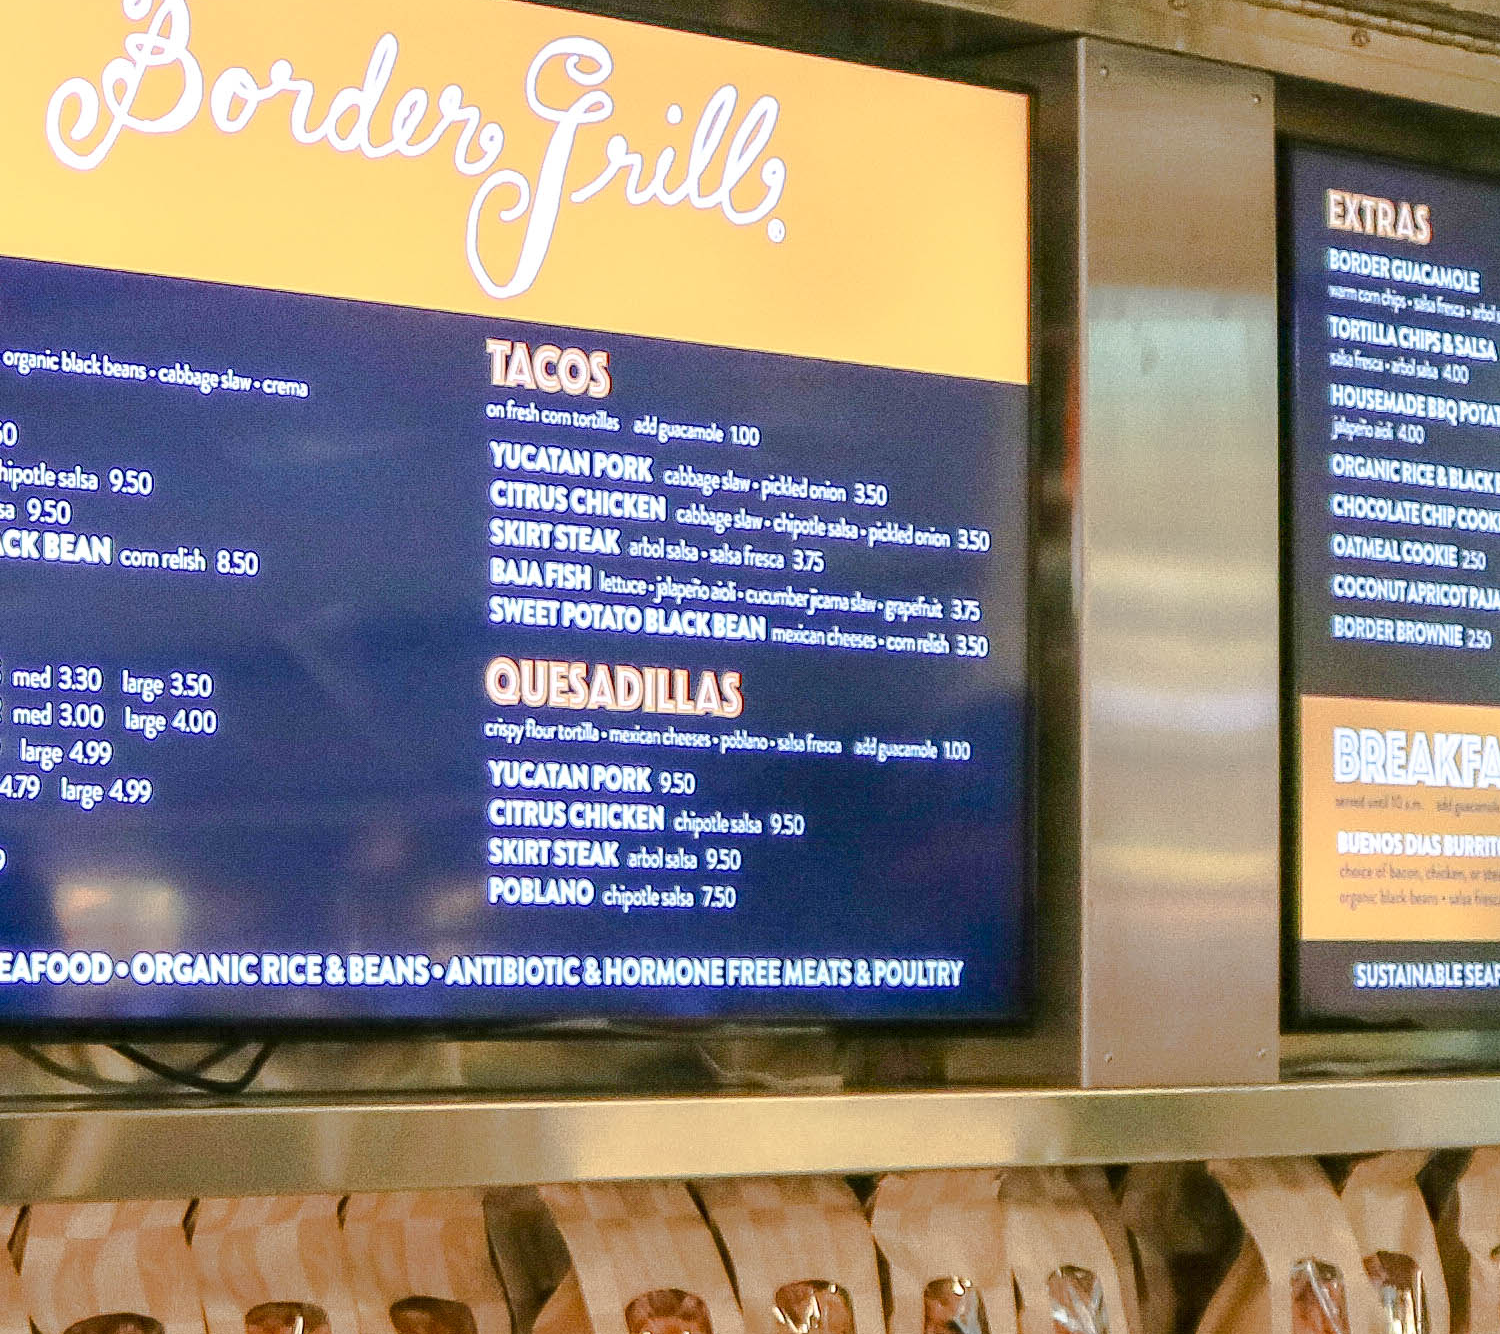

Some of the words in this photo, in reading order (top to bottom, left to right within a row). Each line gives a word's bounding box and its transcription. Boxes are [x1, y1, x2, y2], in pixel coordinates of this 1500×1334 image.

[1326, 187, 1430, 246] EXTRAS
[1328, 315, 1398, 348] TORTILLA
[1397, 326, 1442, 354] CHIPS
[1453, 333, 1498, 362] SALSA
[2, 348, 59, 376] organic
[60, 349, 103, 376] black
[102, 354, 148, 381] beans
[157, 361, 220, 395] cabbage
[220, 368, 253, 392] slaw
[261, 378, 309, 398] crema
[485, 337, 611, 399] TACOS
[1329, 382, 1426, 418] HOUSEMADE
[1426, 395, 1458, 427] BBQ
[729, 424, 760, 447] 1.00
[57, 464, 99, 491] salsa
[108, 467, 153, 496] 9.50
[488, 440, 591, 477] YUCATAN
[592, 451, 654, 483] PORK
[852, 482, 888, 507] 3.50
[1331, 452, 1401, 483] ORGANIC
[1401, 460, 1436, 487] RICE
[1448, 466, 1495, 494] BLACK
[26, 497, 71, 525] 9.50
[1331, 493, 1421, 525] CHOCOLATE
[1420, 502, 1456, 529] CHIP
[42, 531, 111, 565] BEAN
[161, 546, 206, 572] relish
[216, 549, 259, 576] 8.50
[488, 517, 554, 550] SKIRT
[553, 523, 621, 556] STEAK
[792, 548, 825, 573] 3.75
[1332, 534, 1402, 563] OATMEAL
[1401, 540, 1459, 568] COOKIE
[489, 556, 544, 588] BAJA
[544, 560, 592, 591] FISH
[949, 597, 981, 622] 3.75
[12, 664, 52, 689] med
[57, 665, 103, 692] 3.30
[121, 669, 165, 703] large
[169, 671, 213, 698] 3.50
[484, 656, 743, 719] QUESADILLAS
[60, 776, 104, 810] large
[107, 778, 152, 804] 4.99
[1336, 830, 1404, 855] BUENOS
[1402, 832, 1443, 857] DIAS
[484, 875, 595, 906] POBLANO
[700, 884, 737, 909] 7.50
[131, 952, 258, 985] ORGANIC
[262, 954, 323, 985] RICE
[325, 954, 346, 985] &
[348, 954, 430, 986] BEANS
[444, 955, 580, 986] ANTIBIOTIC
[583, 956, 602, 986] &
[604, 956, 725, 986] HORMONE
[727, 959, 782, 986] FREE
[783, 959, 852, 986] MEATS
[855, 959, 871, 986] &
[874, 960, 964, 987] POULTRY
